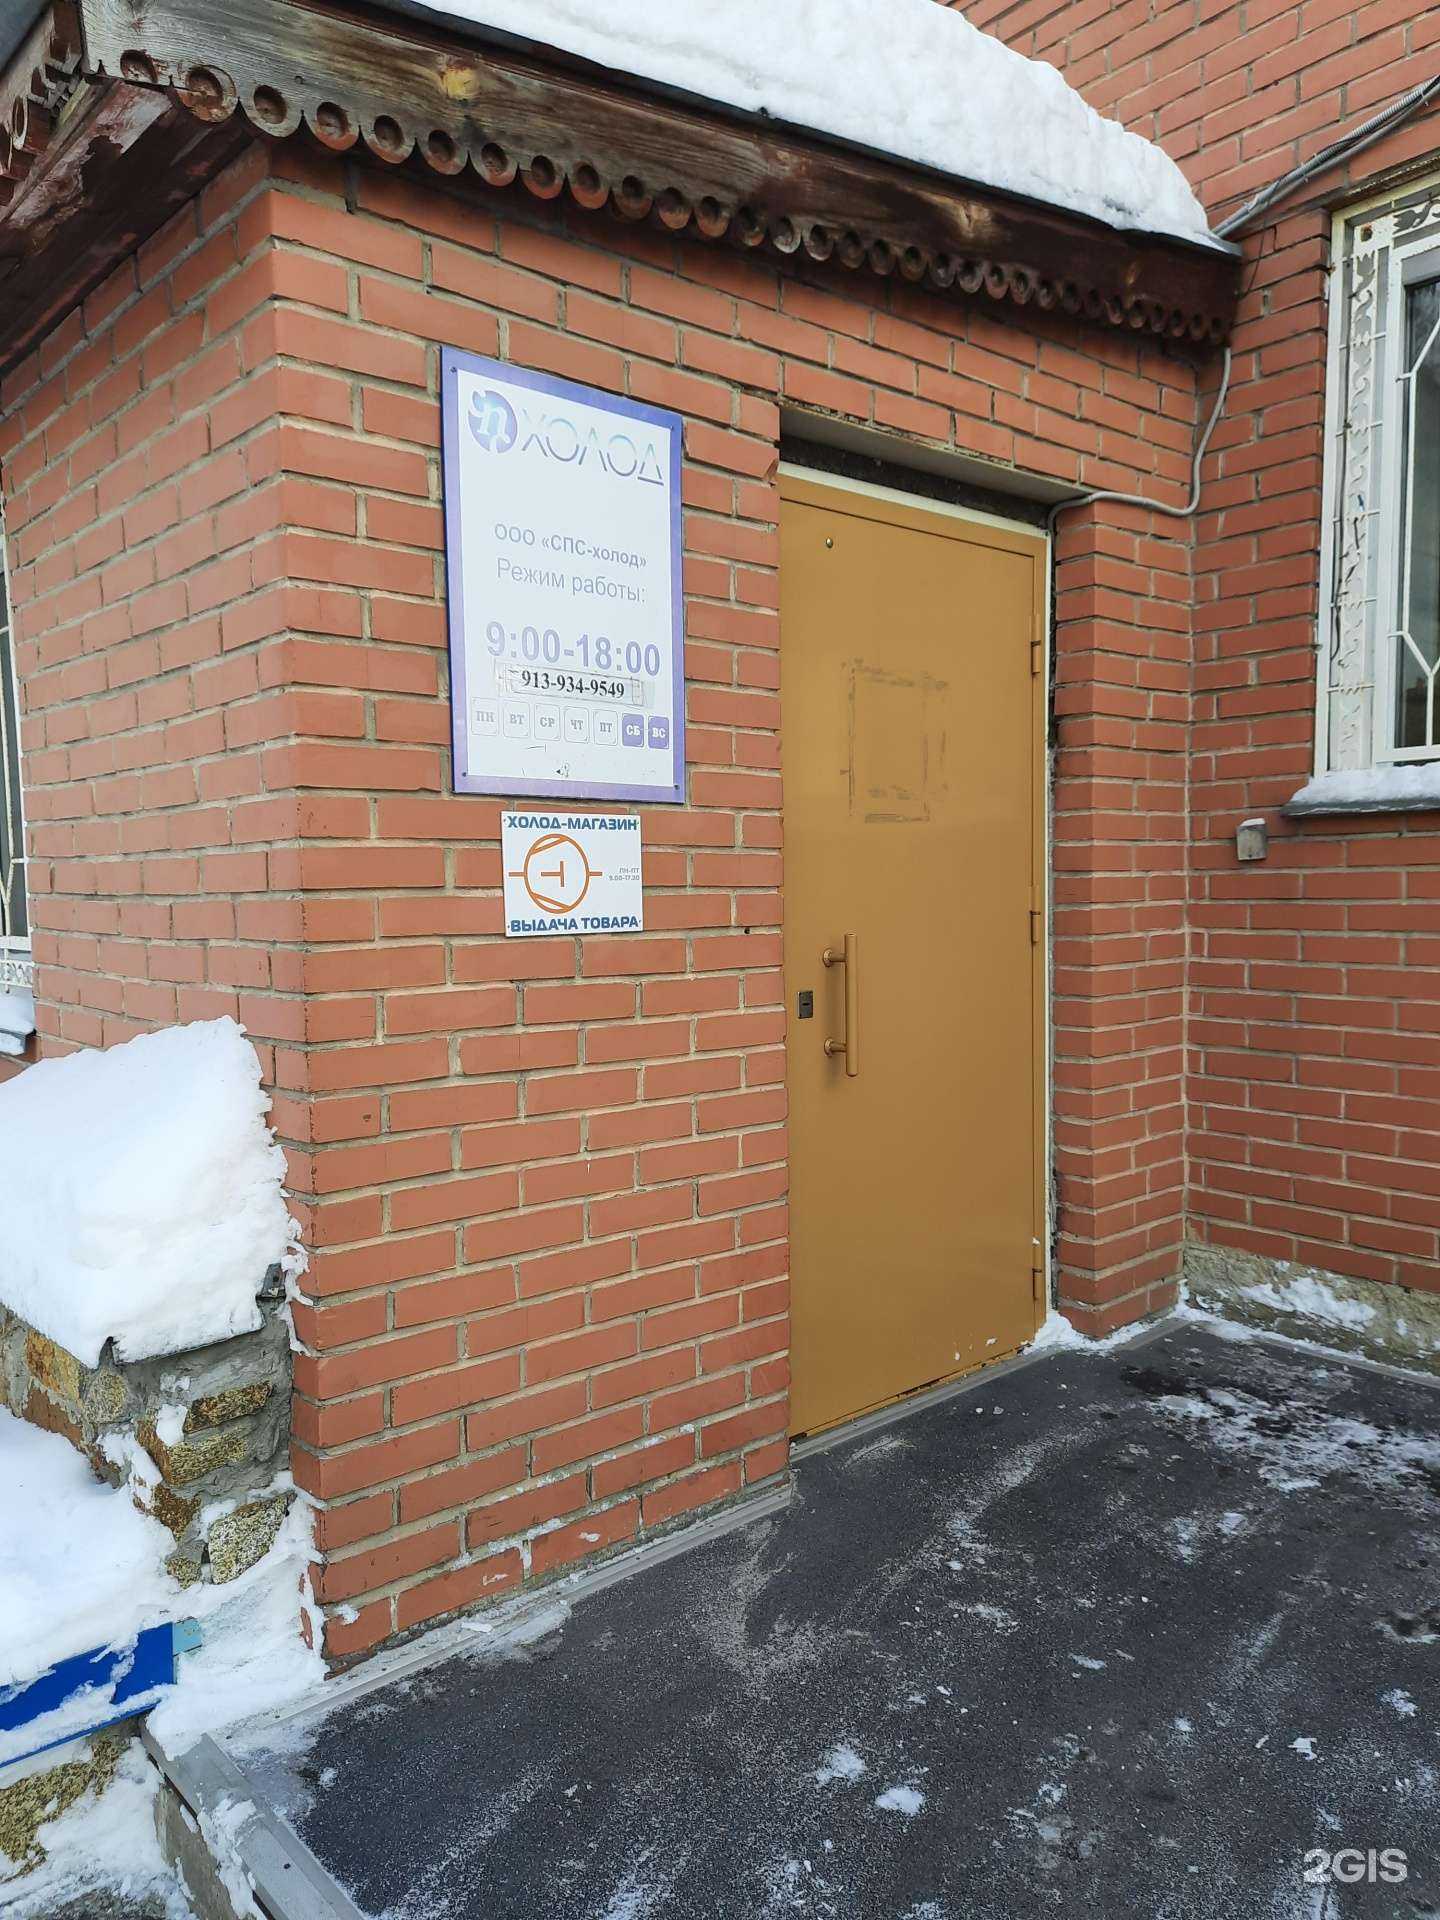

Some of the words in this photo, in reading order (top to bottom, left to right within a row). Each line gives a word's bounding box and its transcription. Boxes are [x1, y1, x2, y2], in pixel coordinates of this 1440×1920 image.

[494, 523, 536, 546] ООО
[541, 534, 647, 569] «СПС-холод»
[496, 557, 565, 589] Режим
[571, 575, 646, 603] работы:
[486, 621, 661, 677] 9:00-18:00
[475, 711, 495, 723] ПН
[509, 713, 525, 725] ВТ
[539, 717, 555, 728] СР
[570, 719, 584, 730] ЧТ
[599, 722, 612, 733] ПТ
[626, 724, 641, 736] СБ
[652, 727, 666, 738] ВС
[507, 815, 638, 831] ХОЛОД-МАГАЗИН
[510, 918, 578, 933] ВЫДАЧА
[581, 916, 639, 930] ТОВАРА
